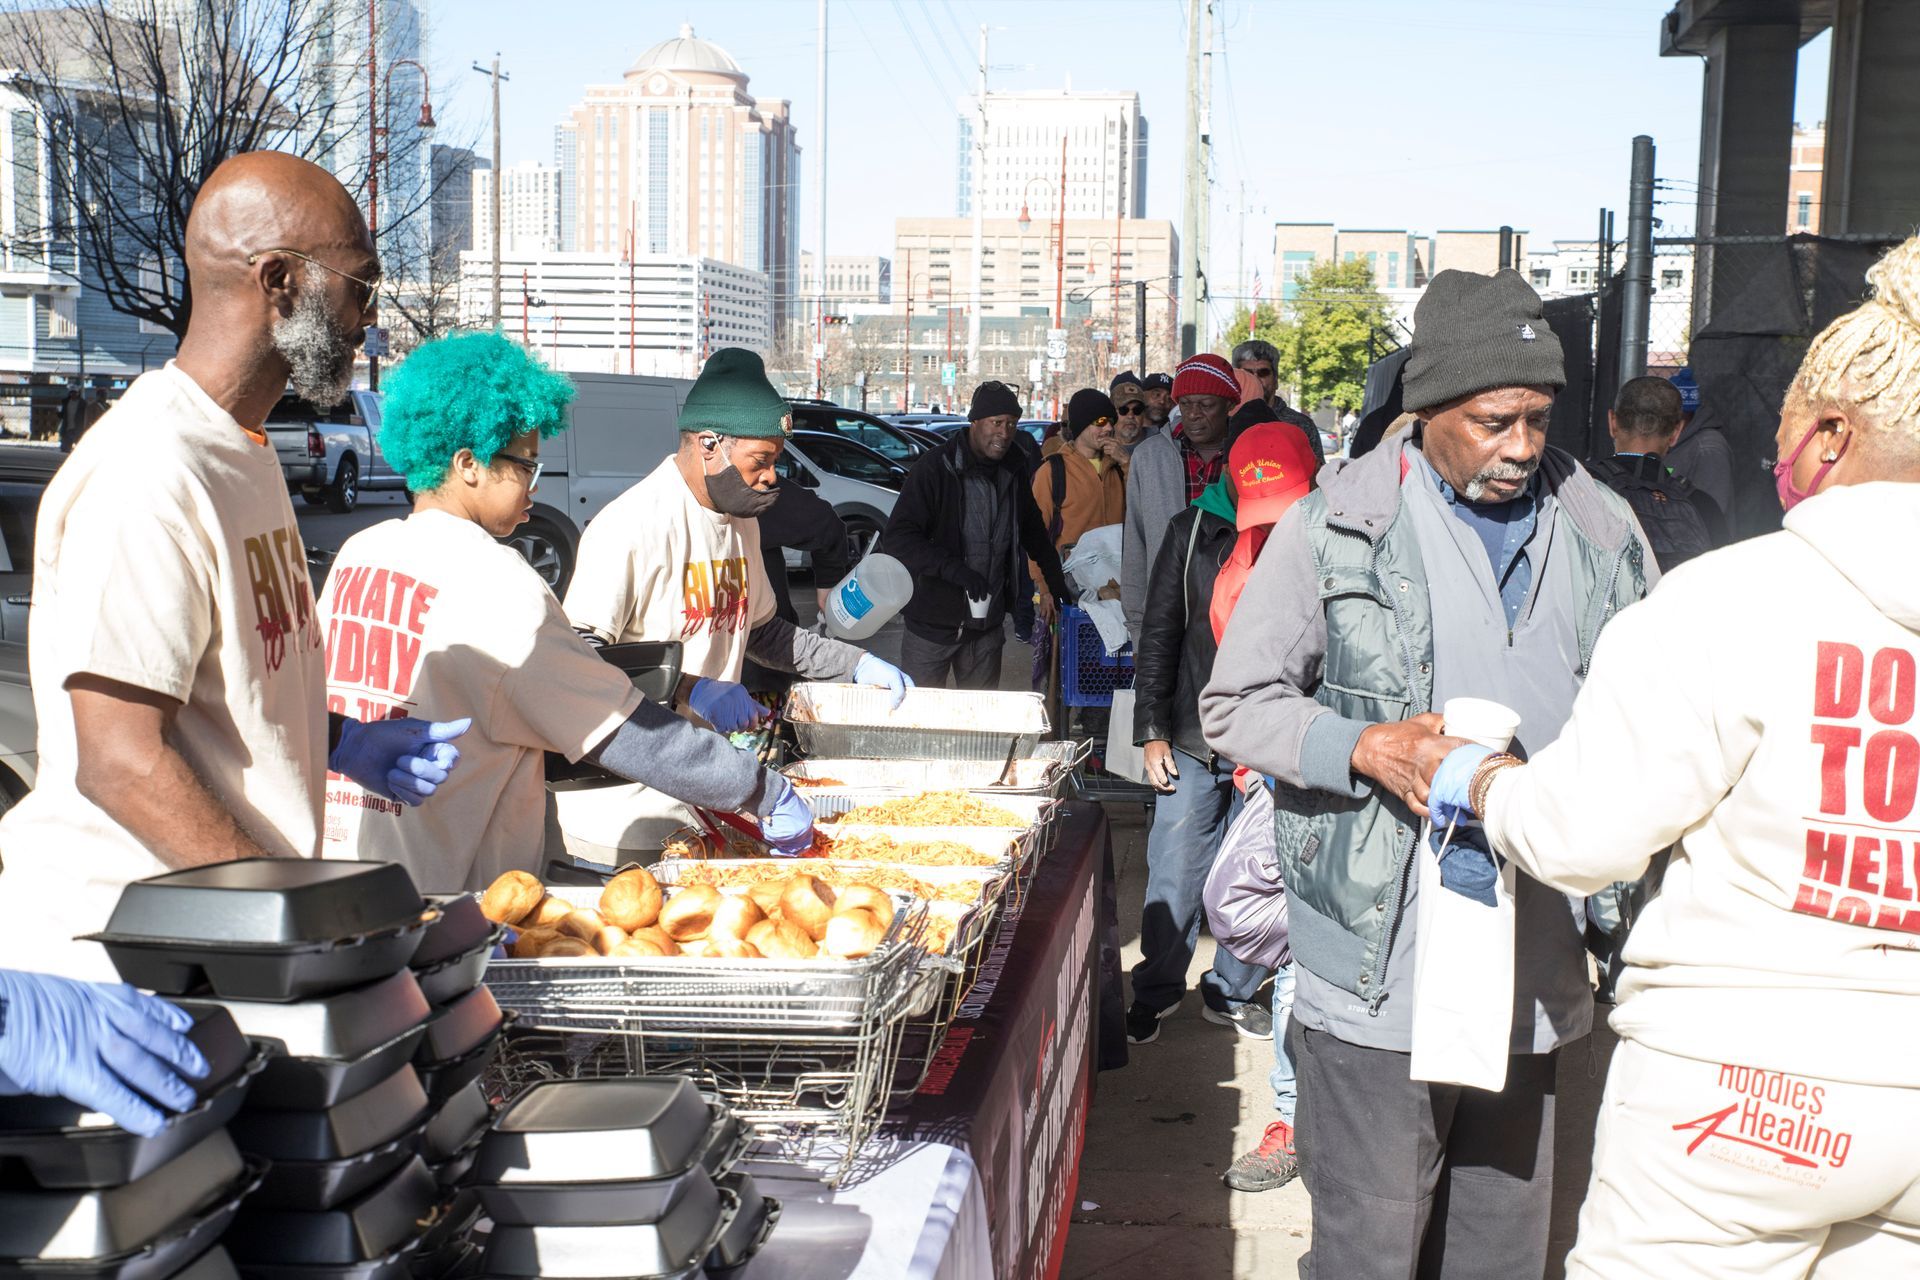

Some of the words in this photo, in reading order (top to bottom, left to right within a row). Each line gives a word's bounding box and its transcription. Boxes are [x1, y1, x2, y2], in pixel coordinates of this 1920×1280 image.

[1049, 343, 1065, 356] 59
[1239, 461, 1257, 477] South
[1257, 458, 1281, 470] Union
[1262, 471, 1284, 483] Church
[332, 566, 440, 636] ONATE
[326, 617, 422, 697] ODAY
[1814, 640, 1917, 726] DO
[325, 790, 402, 817] s4Healing.org
[1810, 723, 1920, 824] TO
[1802, 828, 1920, 903] HEL
[1028, 1115, 1049, 1248] HELP
[1049, 1066, 1063, 1174] THE
[1710, 1142, 1828, 1183] FOUNDATION
[1739, 1098, 1852, 1168] Healing
